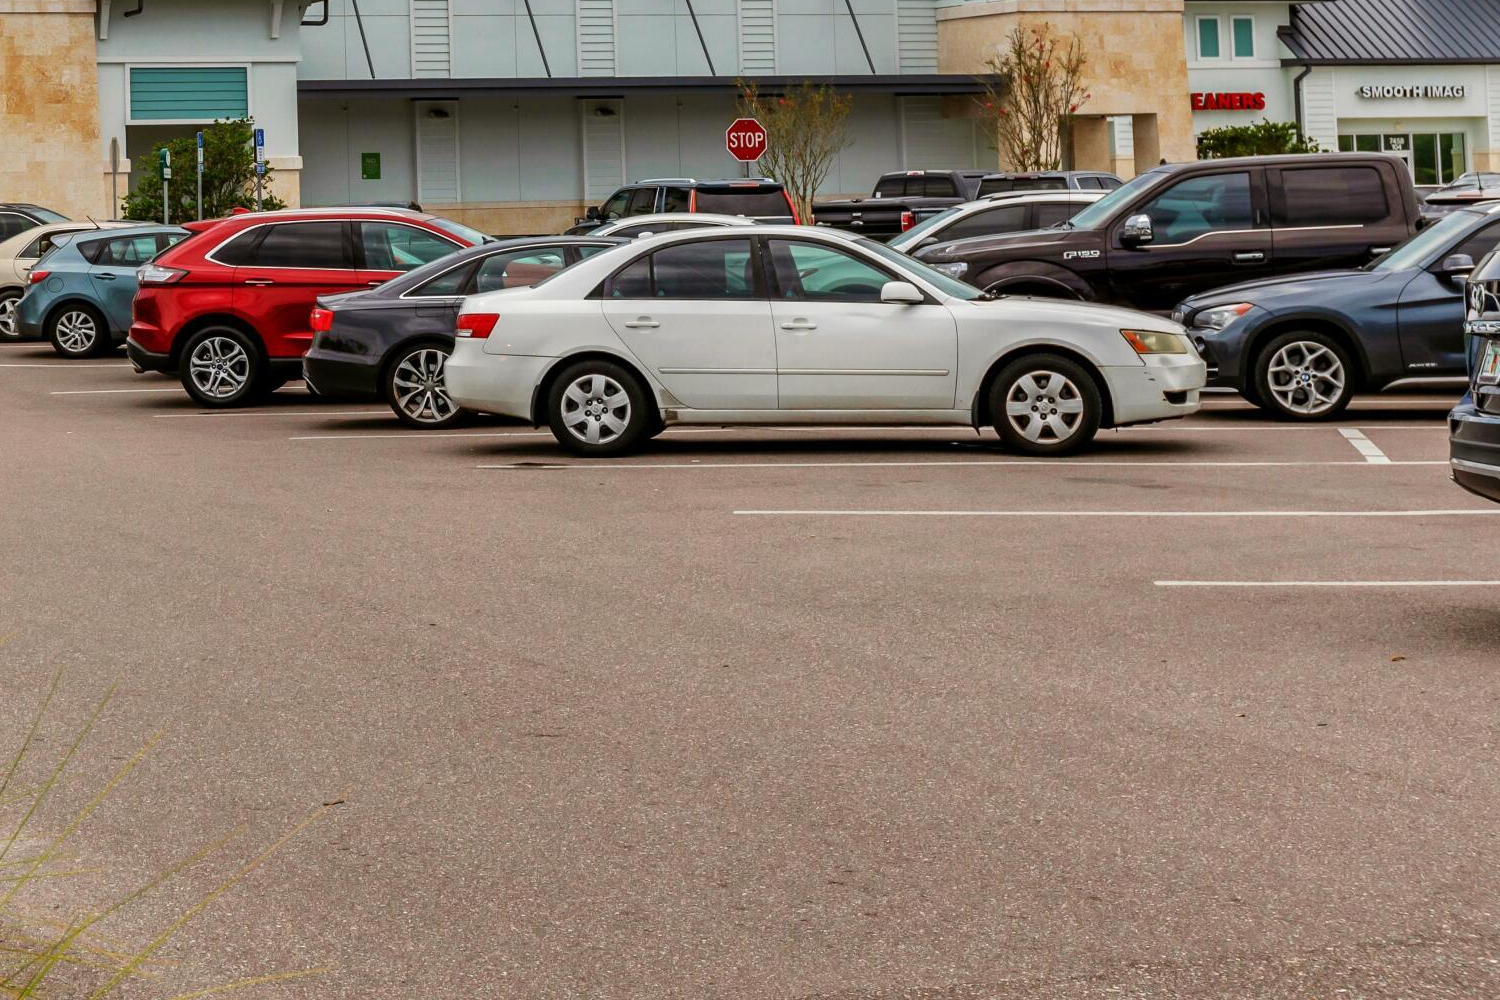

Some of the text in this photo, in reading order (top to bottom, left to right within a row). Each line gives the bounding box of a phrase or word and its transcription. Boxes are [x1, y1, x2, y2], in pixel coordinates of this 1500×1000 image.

[1361, 85, 1422, 99] SMOOTH
[1190, 92, 1266, 111] EANERS
[729, 132, 764, 148] STOP
